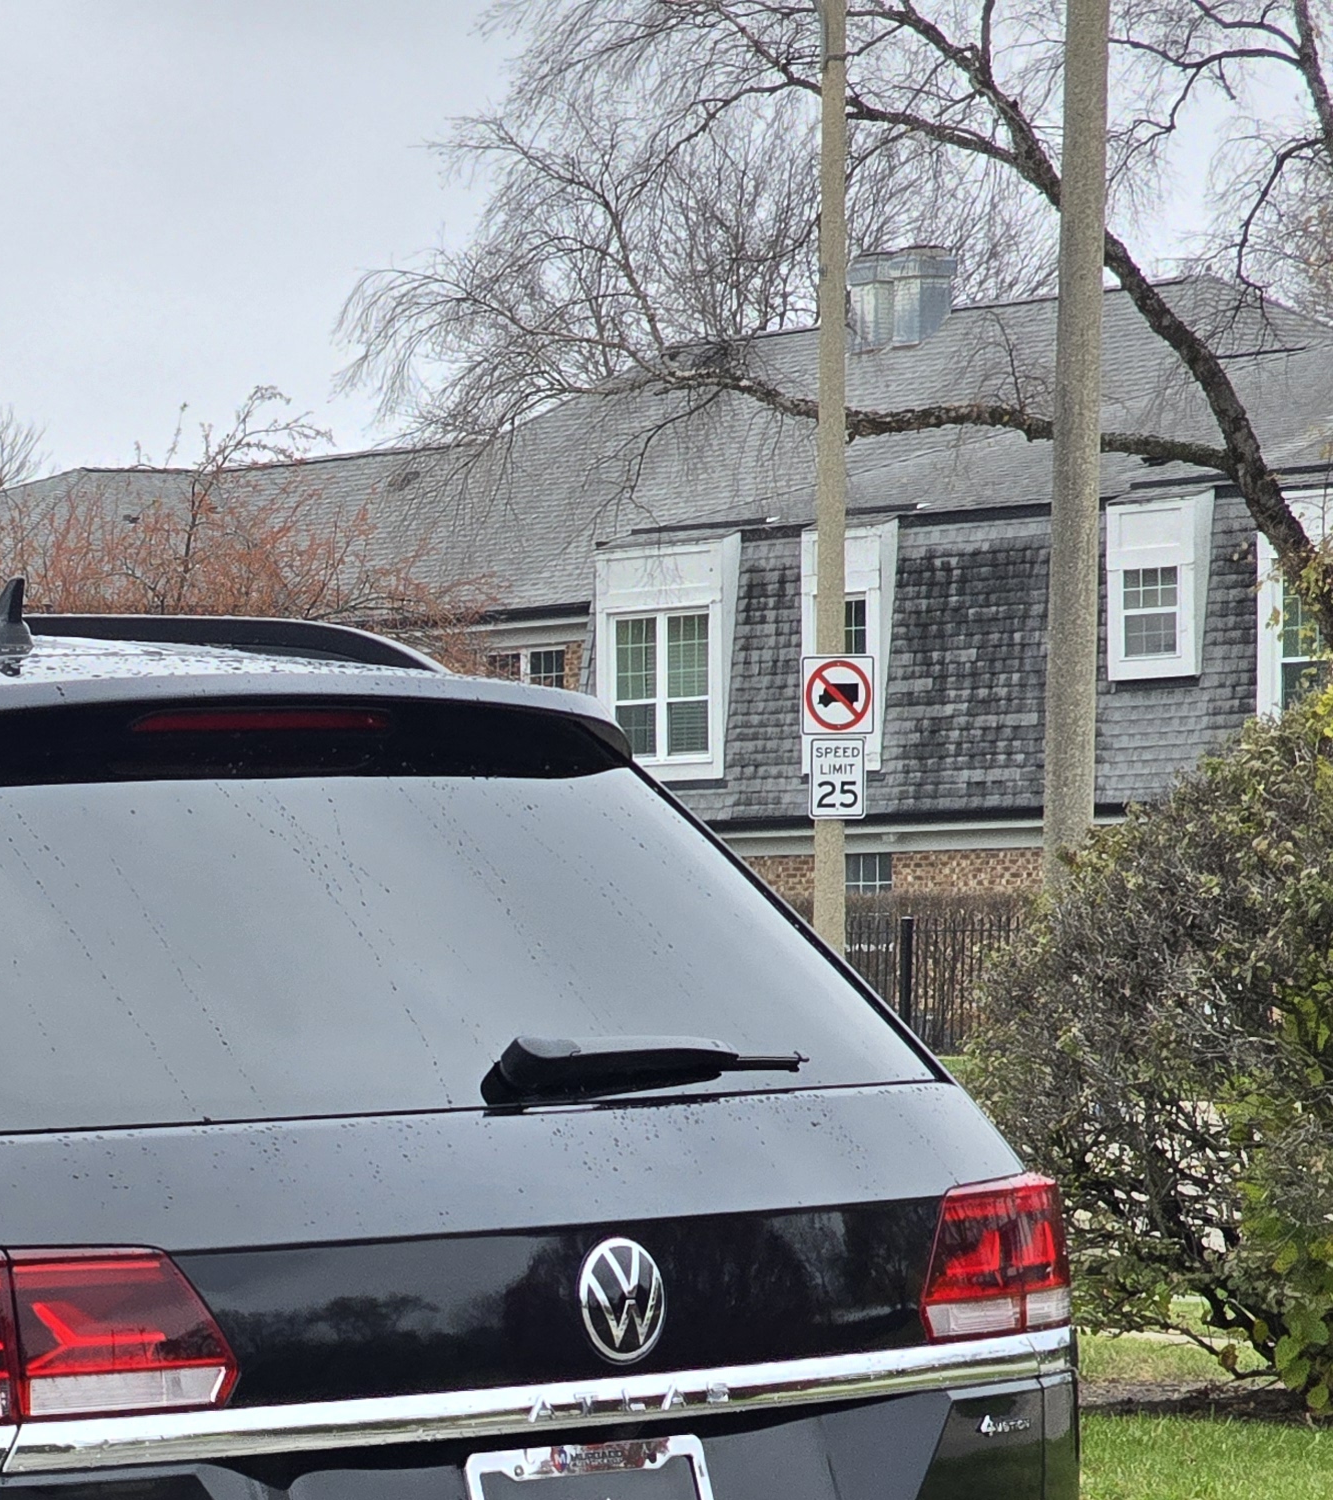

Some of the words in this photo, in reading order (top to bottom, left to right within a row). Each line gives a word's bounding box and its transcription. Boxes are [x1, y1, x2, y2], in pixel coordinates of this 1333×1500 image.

[815, 747, 861, 758] SPEED
[820, 764, 855, 775] LIMIT
[816, 781, 858, 808] 25
